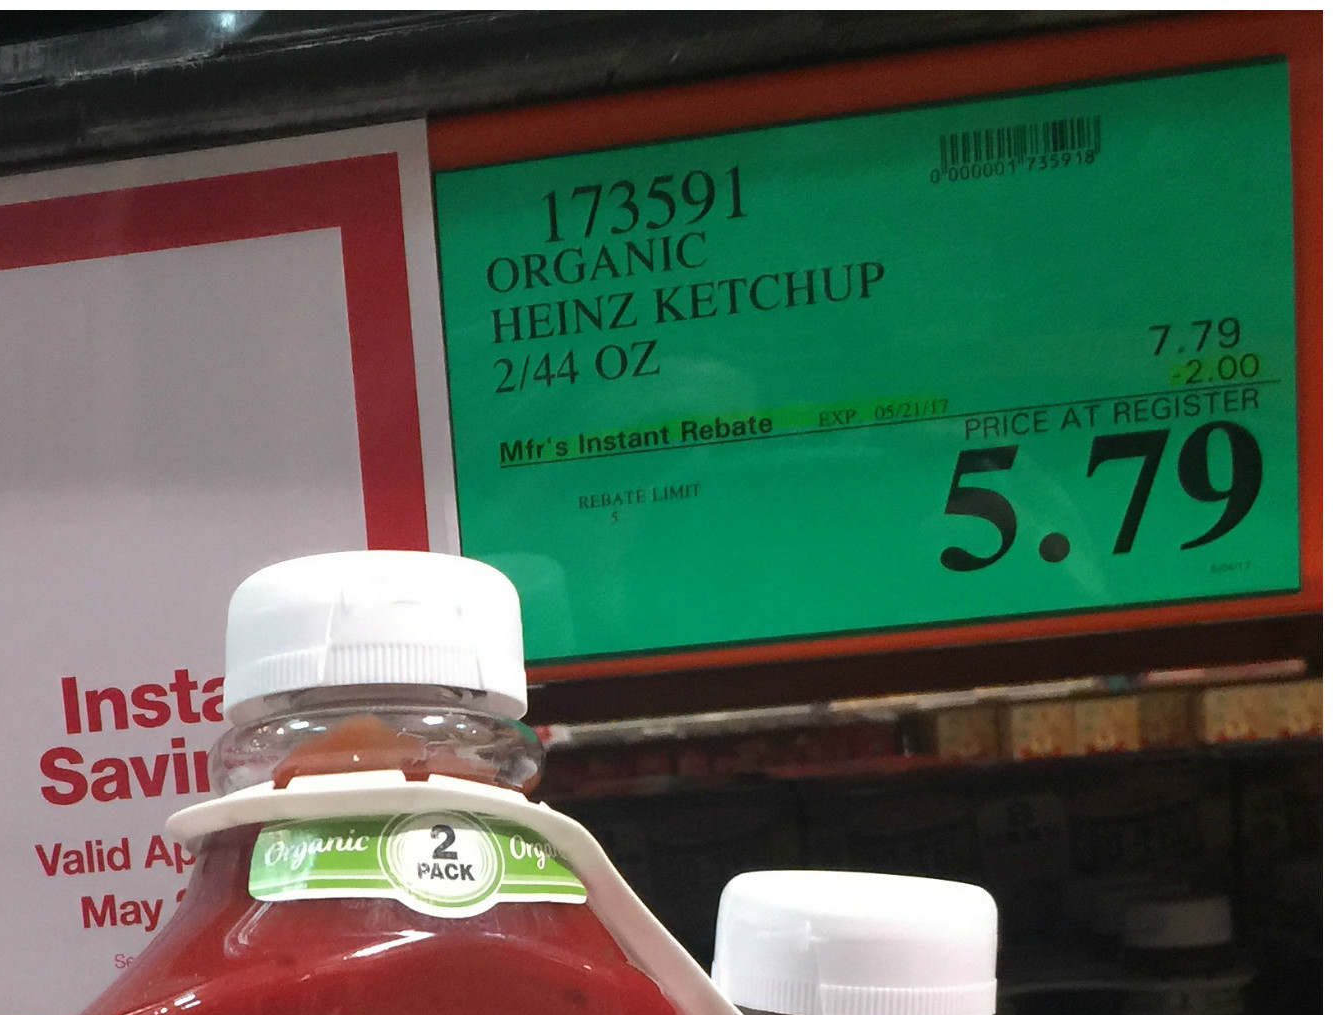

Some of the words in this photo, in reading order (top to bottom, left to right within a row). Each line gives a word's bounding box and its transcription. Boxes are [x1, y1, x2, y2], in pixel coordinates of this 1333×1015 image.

[542, 165, 748, 244] 173591
[486, 231, 708, 293] ORGANIC
[491, 291, 638, 344] HEINZ
[653, 261, 885, 324] KETCHUP
[1148, 318, 1241, 356] 7.79
[493, 349, 579, 394] 2/44
[595, 339, 661, 381] OZ
[1171, 353, 1260, 386] -2.00
[964, 406, 1049, 441] PRICE
[1060, 403, 1099, 431] AT
[1114, 386, 1260, 424] REGISTER
[499, 438, 569, 464] Mfr's
[578, 428, 670, 455] Instant
[680, 415, 774, 443] Rebate
[939, 419, 1264, 573] 5.79
[34, 837, 131, 877] Valid
[430, 824, 458, 861] 2
[416, 862, 476, 882] PACK
[81, 894, 164, 932] May
